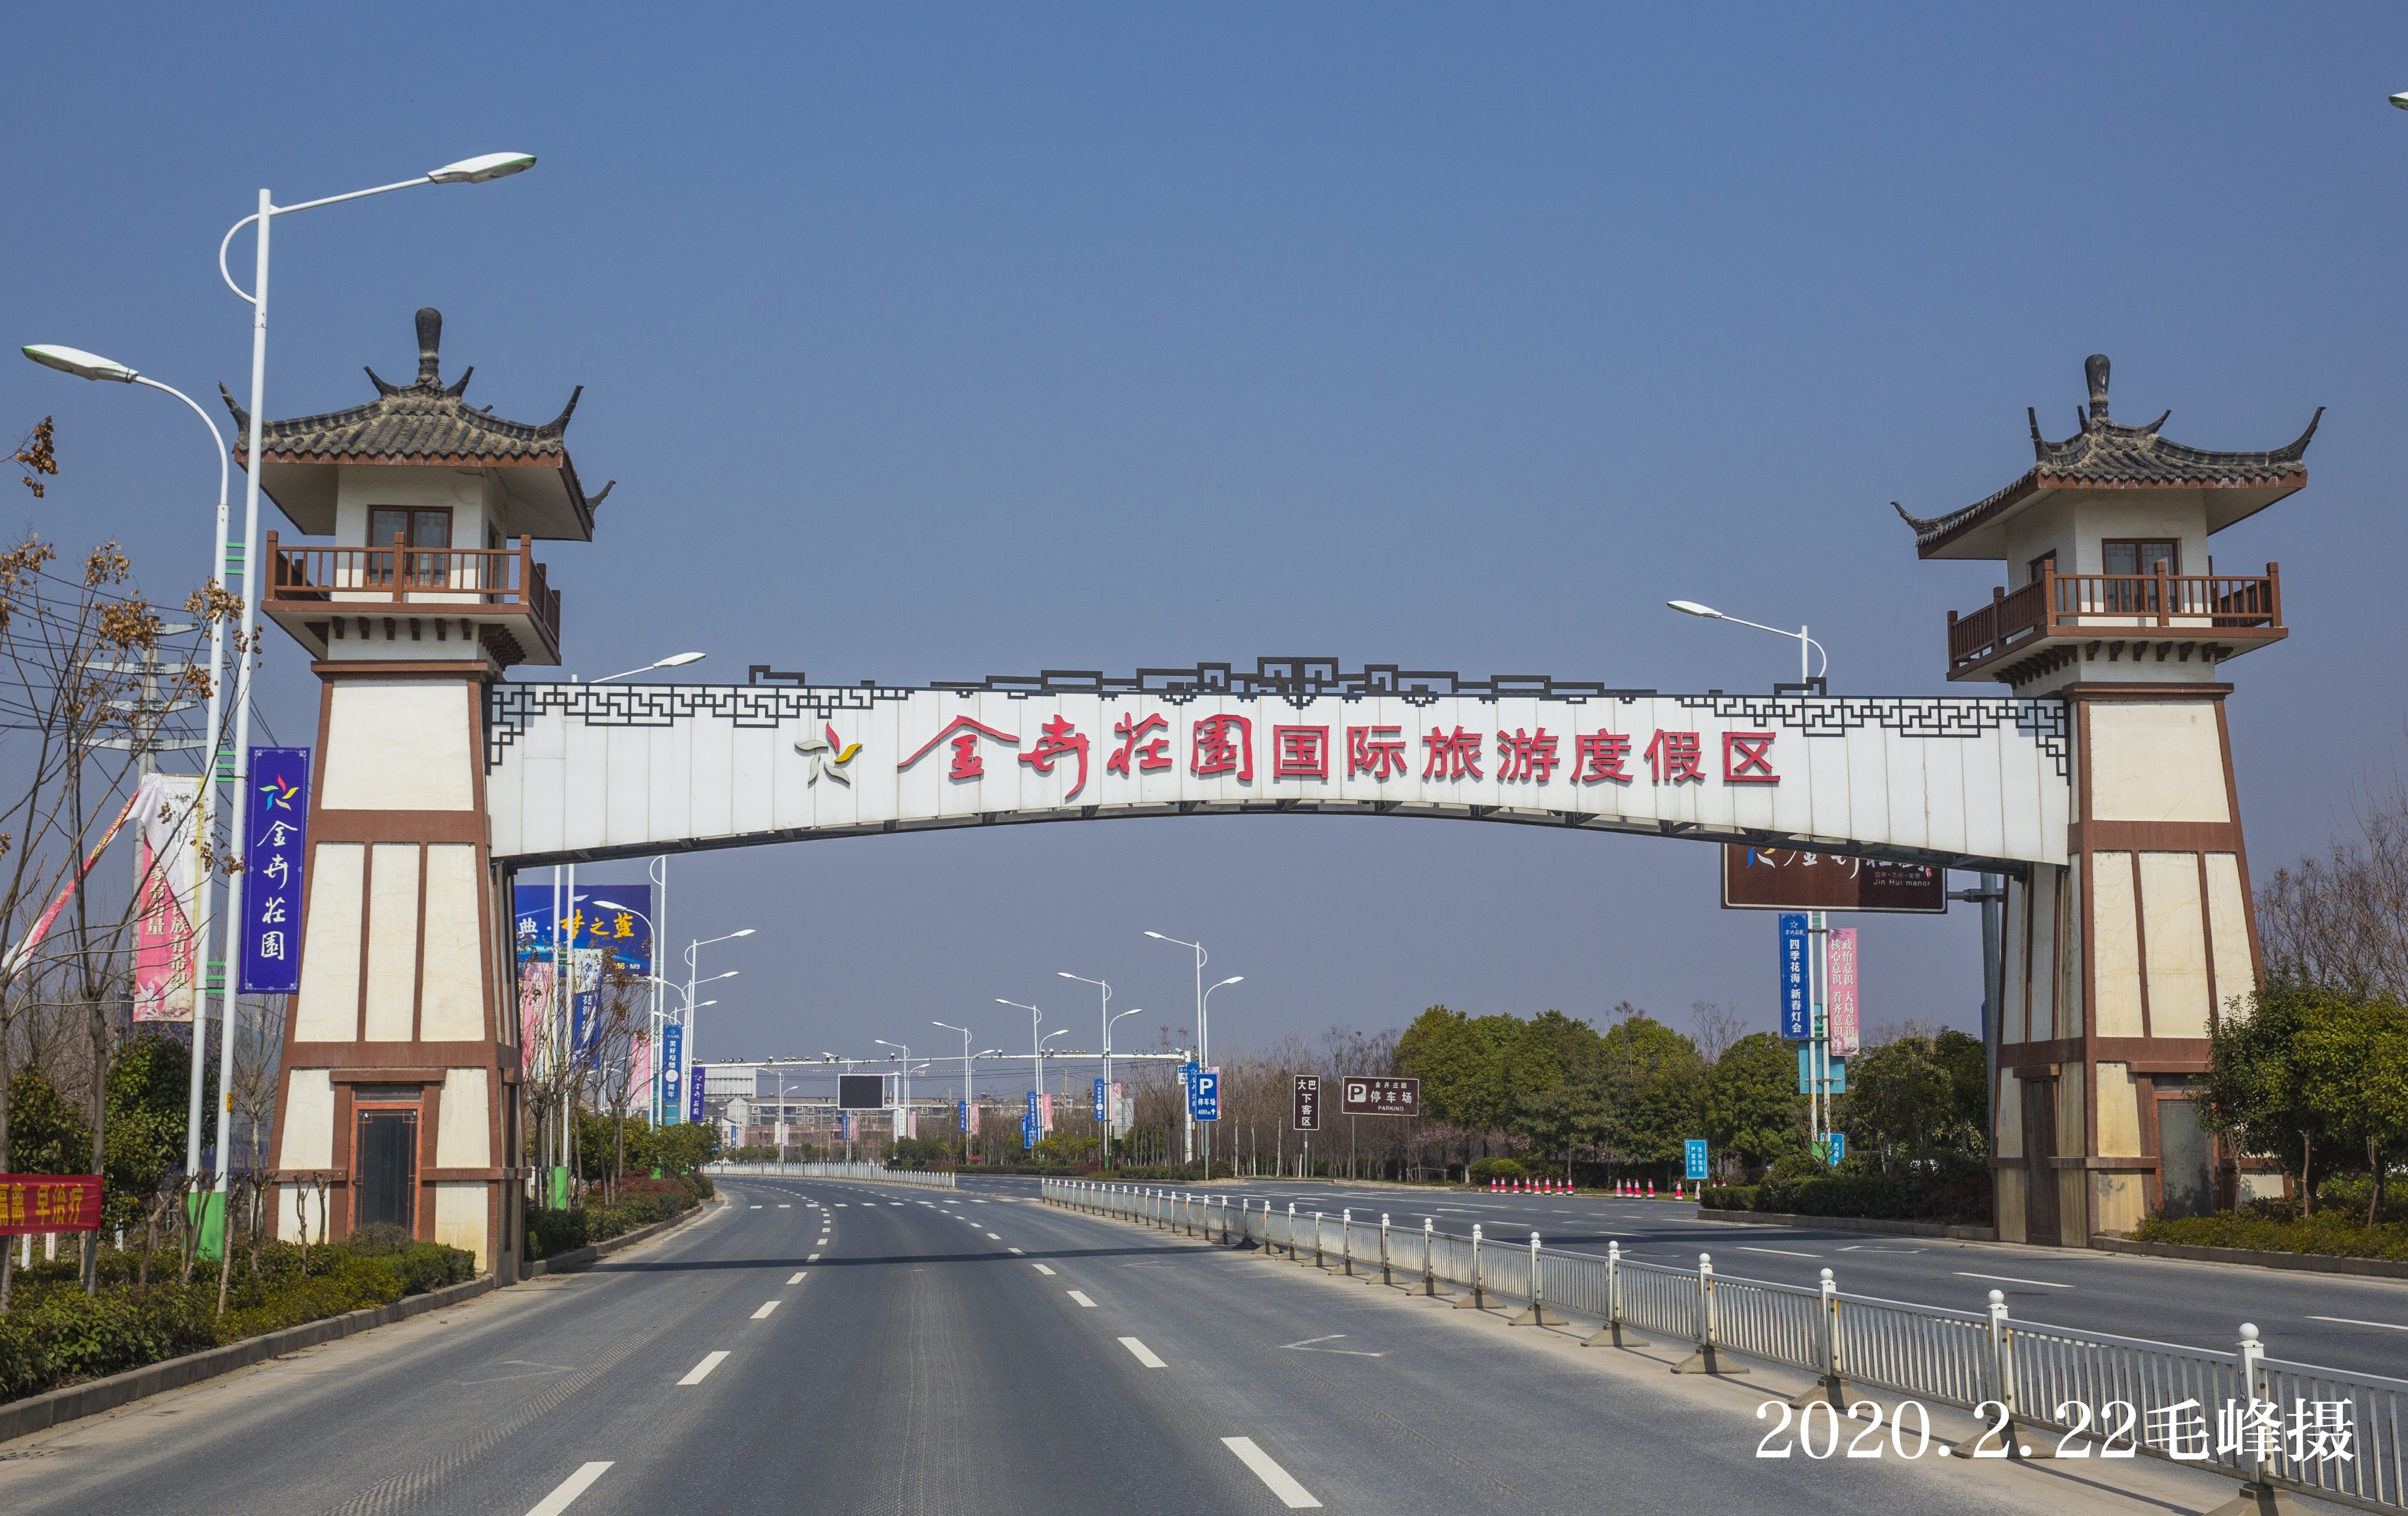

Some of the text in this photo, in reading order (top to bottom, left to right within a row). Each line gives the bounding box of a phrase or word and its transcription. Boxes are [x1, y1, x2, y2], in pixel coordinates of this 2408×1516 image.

[1790, 939, 1801, 1033] 四季花海·新春灯会
[1830, 939, 1844, 1038] 核心意识 看齐意识
[1842, 939, 1855, 1038] 政治意识 大局意识
[1199, 1078, 1214, 1095] P
[1297, 1079, 1316, 1090] 大巴
[1370, 1091, 1412, 1103] 停车场
[1302, 1093, 1312, 1126] 下客区
[35, 1184, 83, 1225] 早治疗
